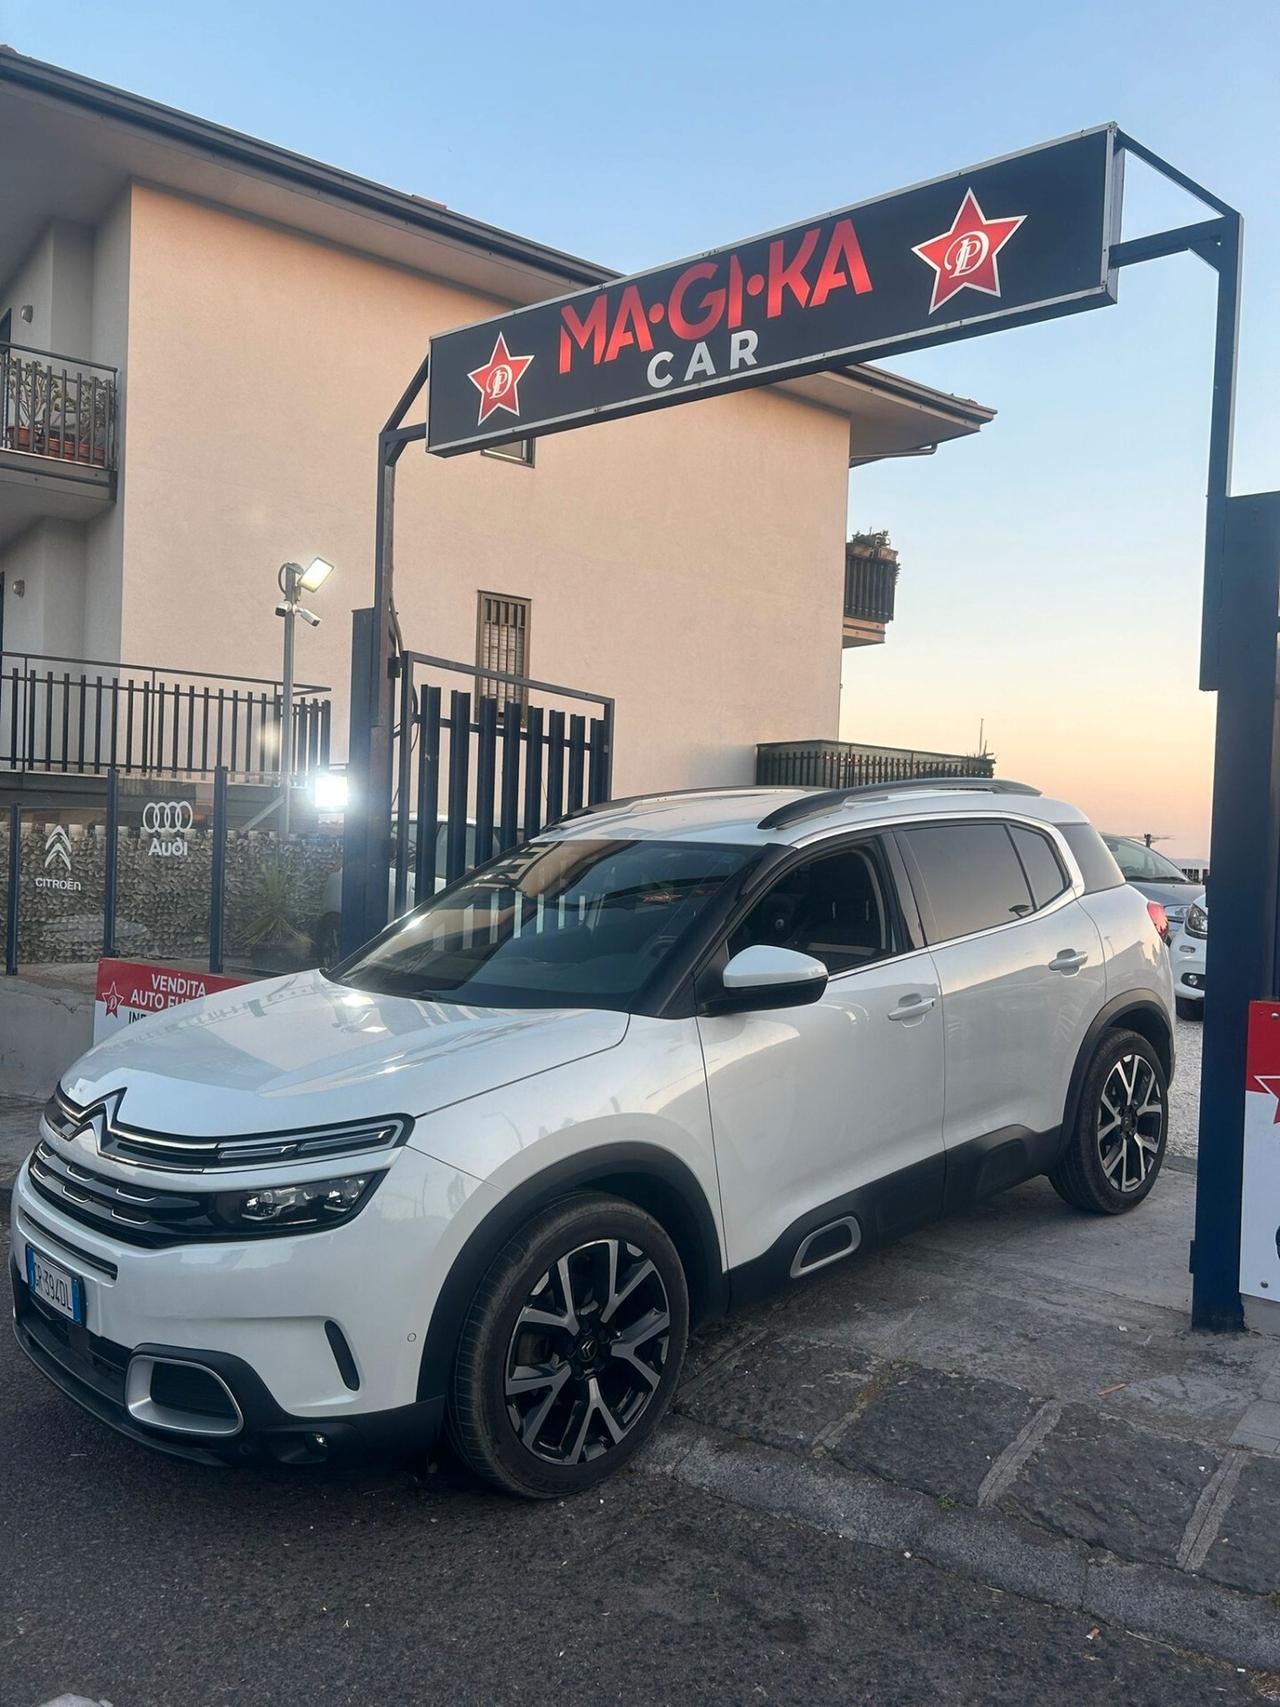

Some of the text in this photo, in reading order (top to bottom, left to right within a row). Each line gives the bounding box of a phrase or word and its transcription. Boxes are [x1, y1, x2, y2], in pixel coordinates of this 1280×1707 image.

[646, 329, 759, 389] CAR
[148, 837, 188, 857] Audi
[151, 973, 207, 998] VENDITA
[130, 989, 165, 1010] AUTO
